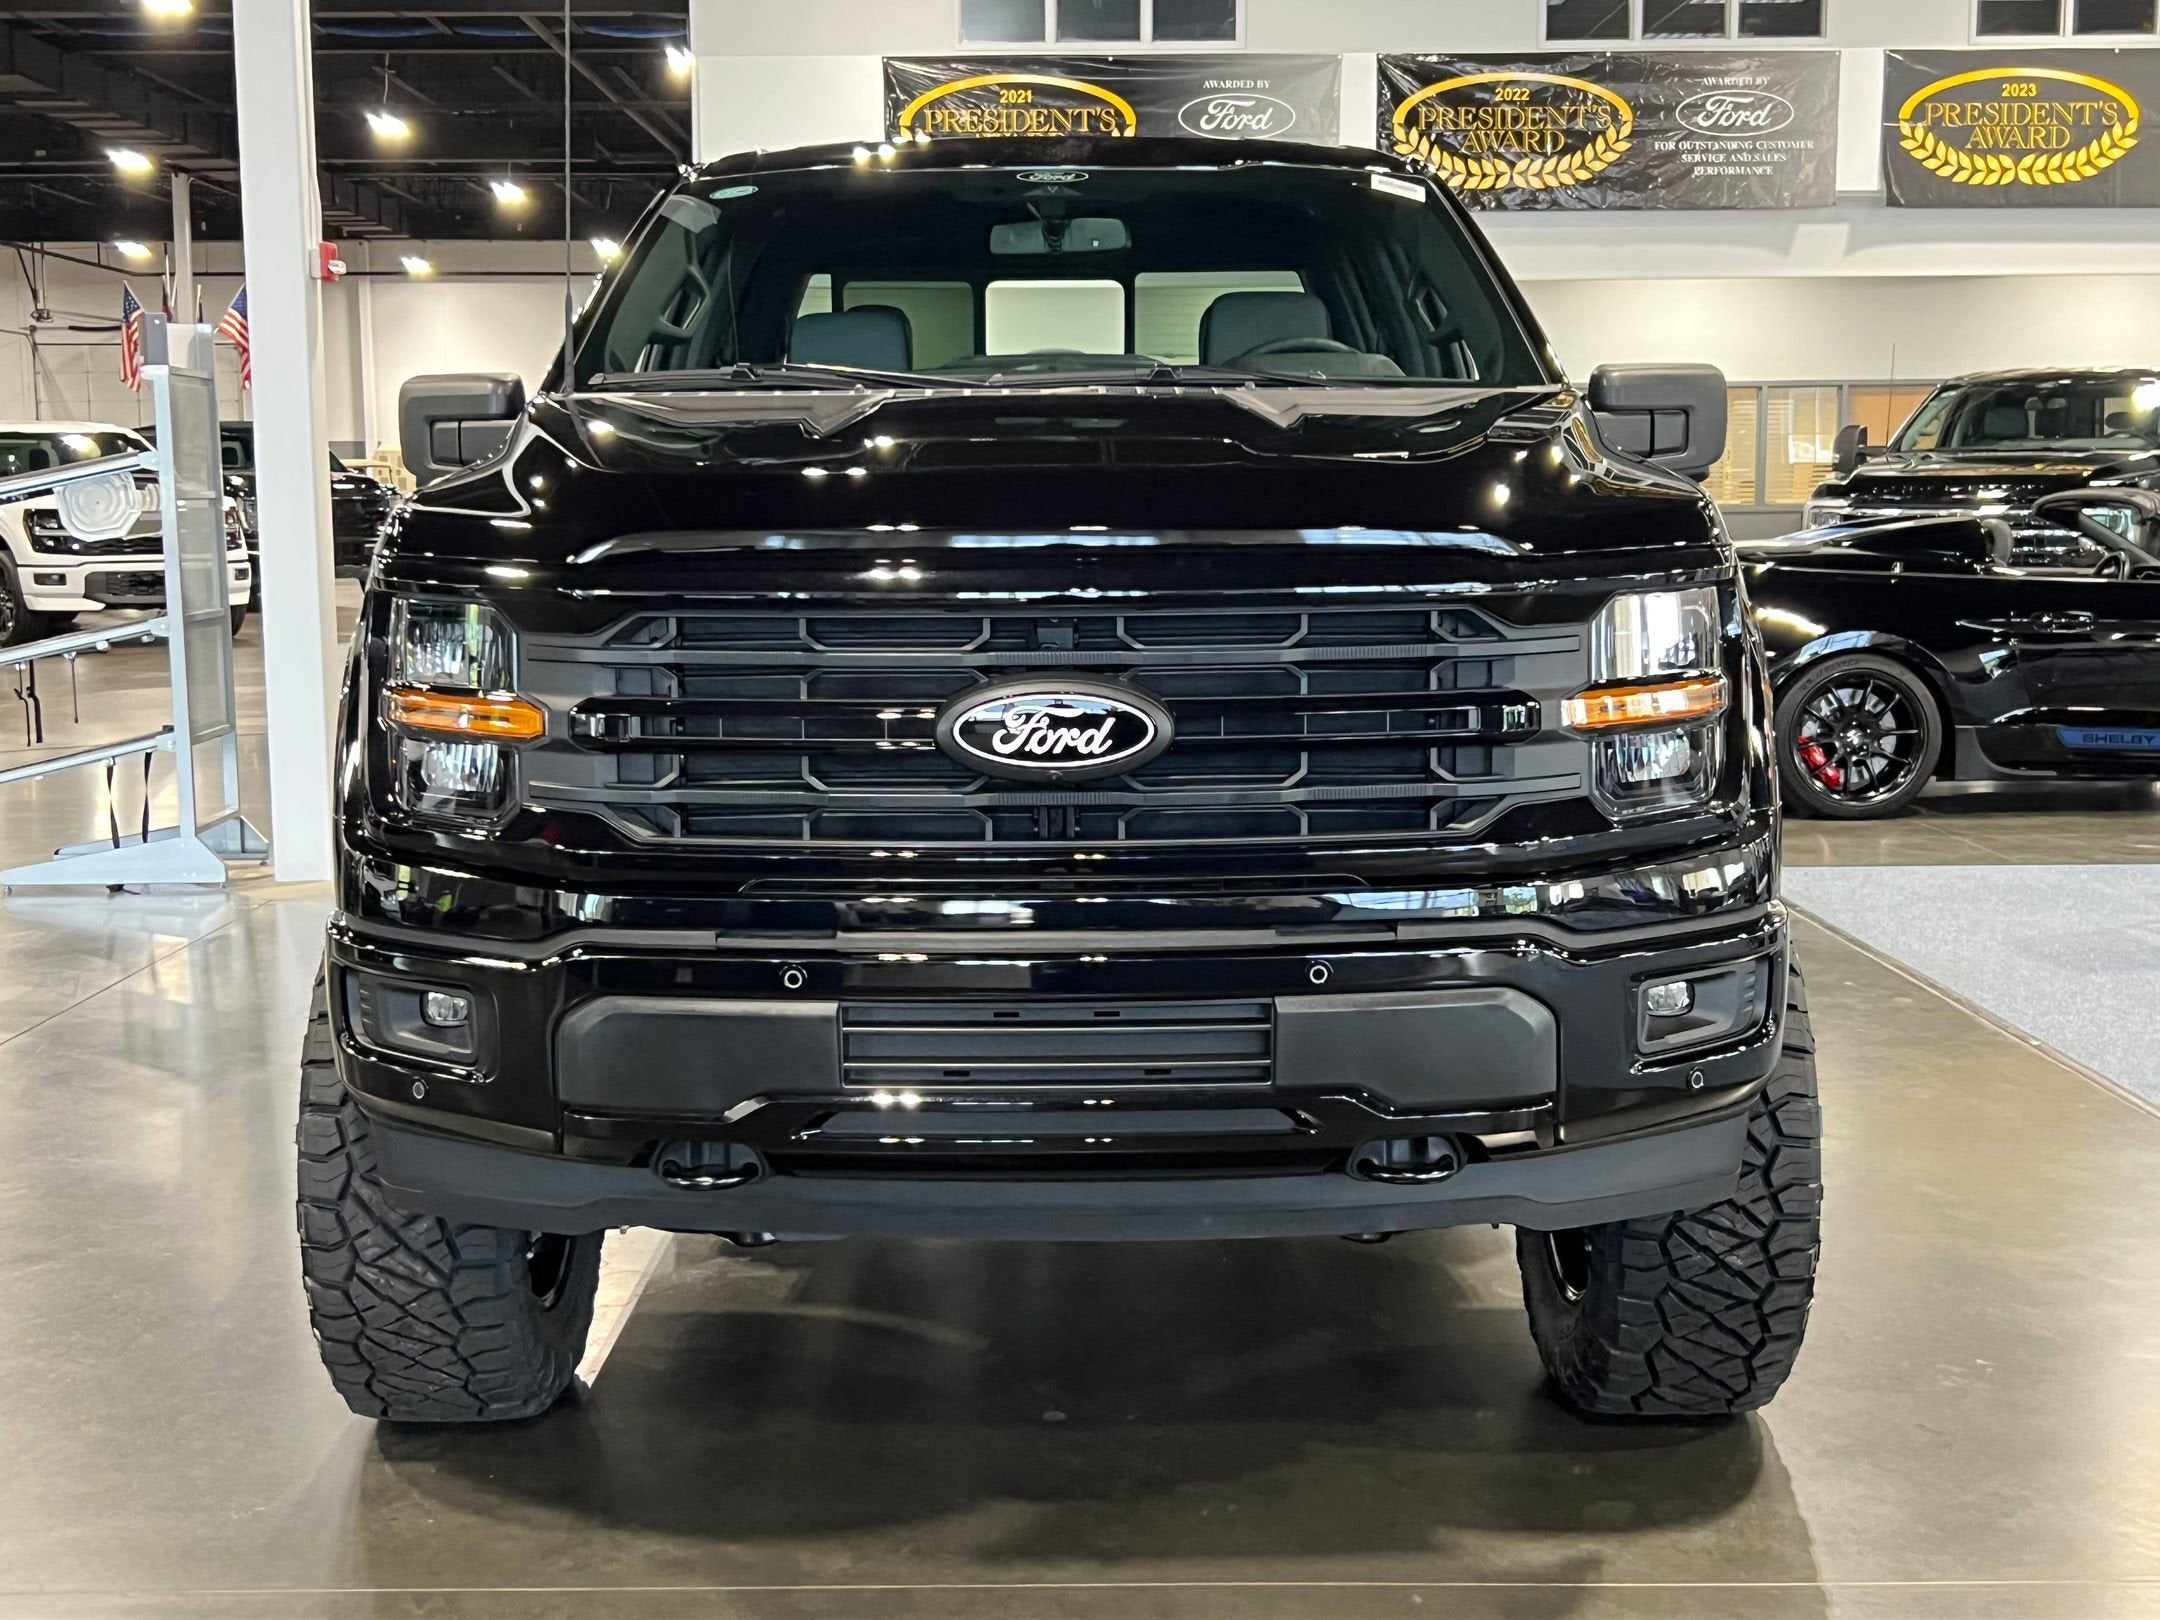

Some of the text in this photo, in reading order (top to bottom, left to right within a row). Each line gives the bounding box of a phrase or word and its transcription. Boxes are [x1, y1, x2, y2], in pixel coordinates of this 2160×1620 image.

[1203, 80, 1271, 89] AWARDED BY
[1755, 77, 1770, 86] BY
[1000, 89, 1033, 104] 2021
[1494, 88, 1530, 101] 2022
[2001, 83, 2037, 97] 2023
[1200, 99, 1274, 130] Ford
[1418, 105, 1612, 130] PRESIDENT'S
[1698, 95, 1774, 127] Ford
[1924, 101, 2118, 126] PRESIDENT'S
[925, 107, 1117, 133] PRESIDENT'S
[1459, 130, 1566, 153] AWARD
[1964, 126, 2071, 149] AWARD
[1654, 140, 1815, 151] FOR OUTSTANDING CUSTOMER
[1681, 152, 1787, 163] SERVICE AND SALES
[1694, 166, 1774, 176] PERFORMANCE
[992, 705, 1116, 755] Ford
[2082, 733, 2156, 746] SHELBY
